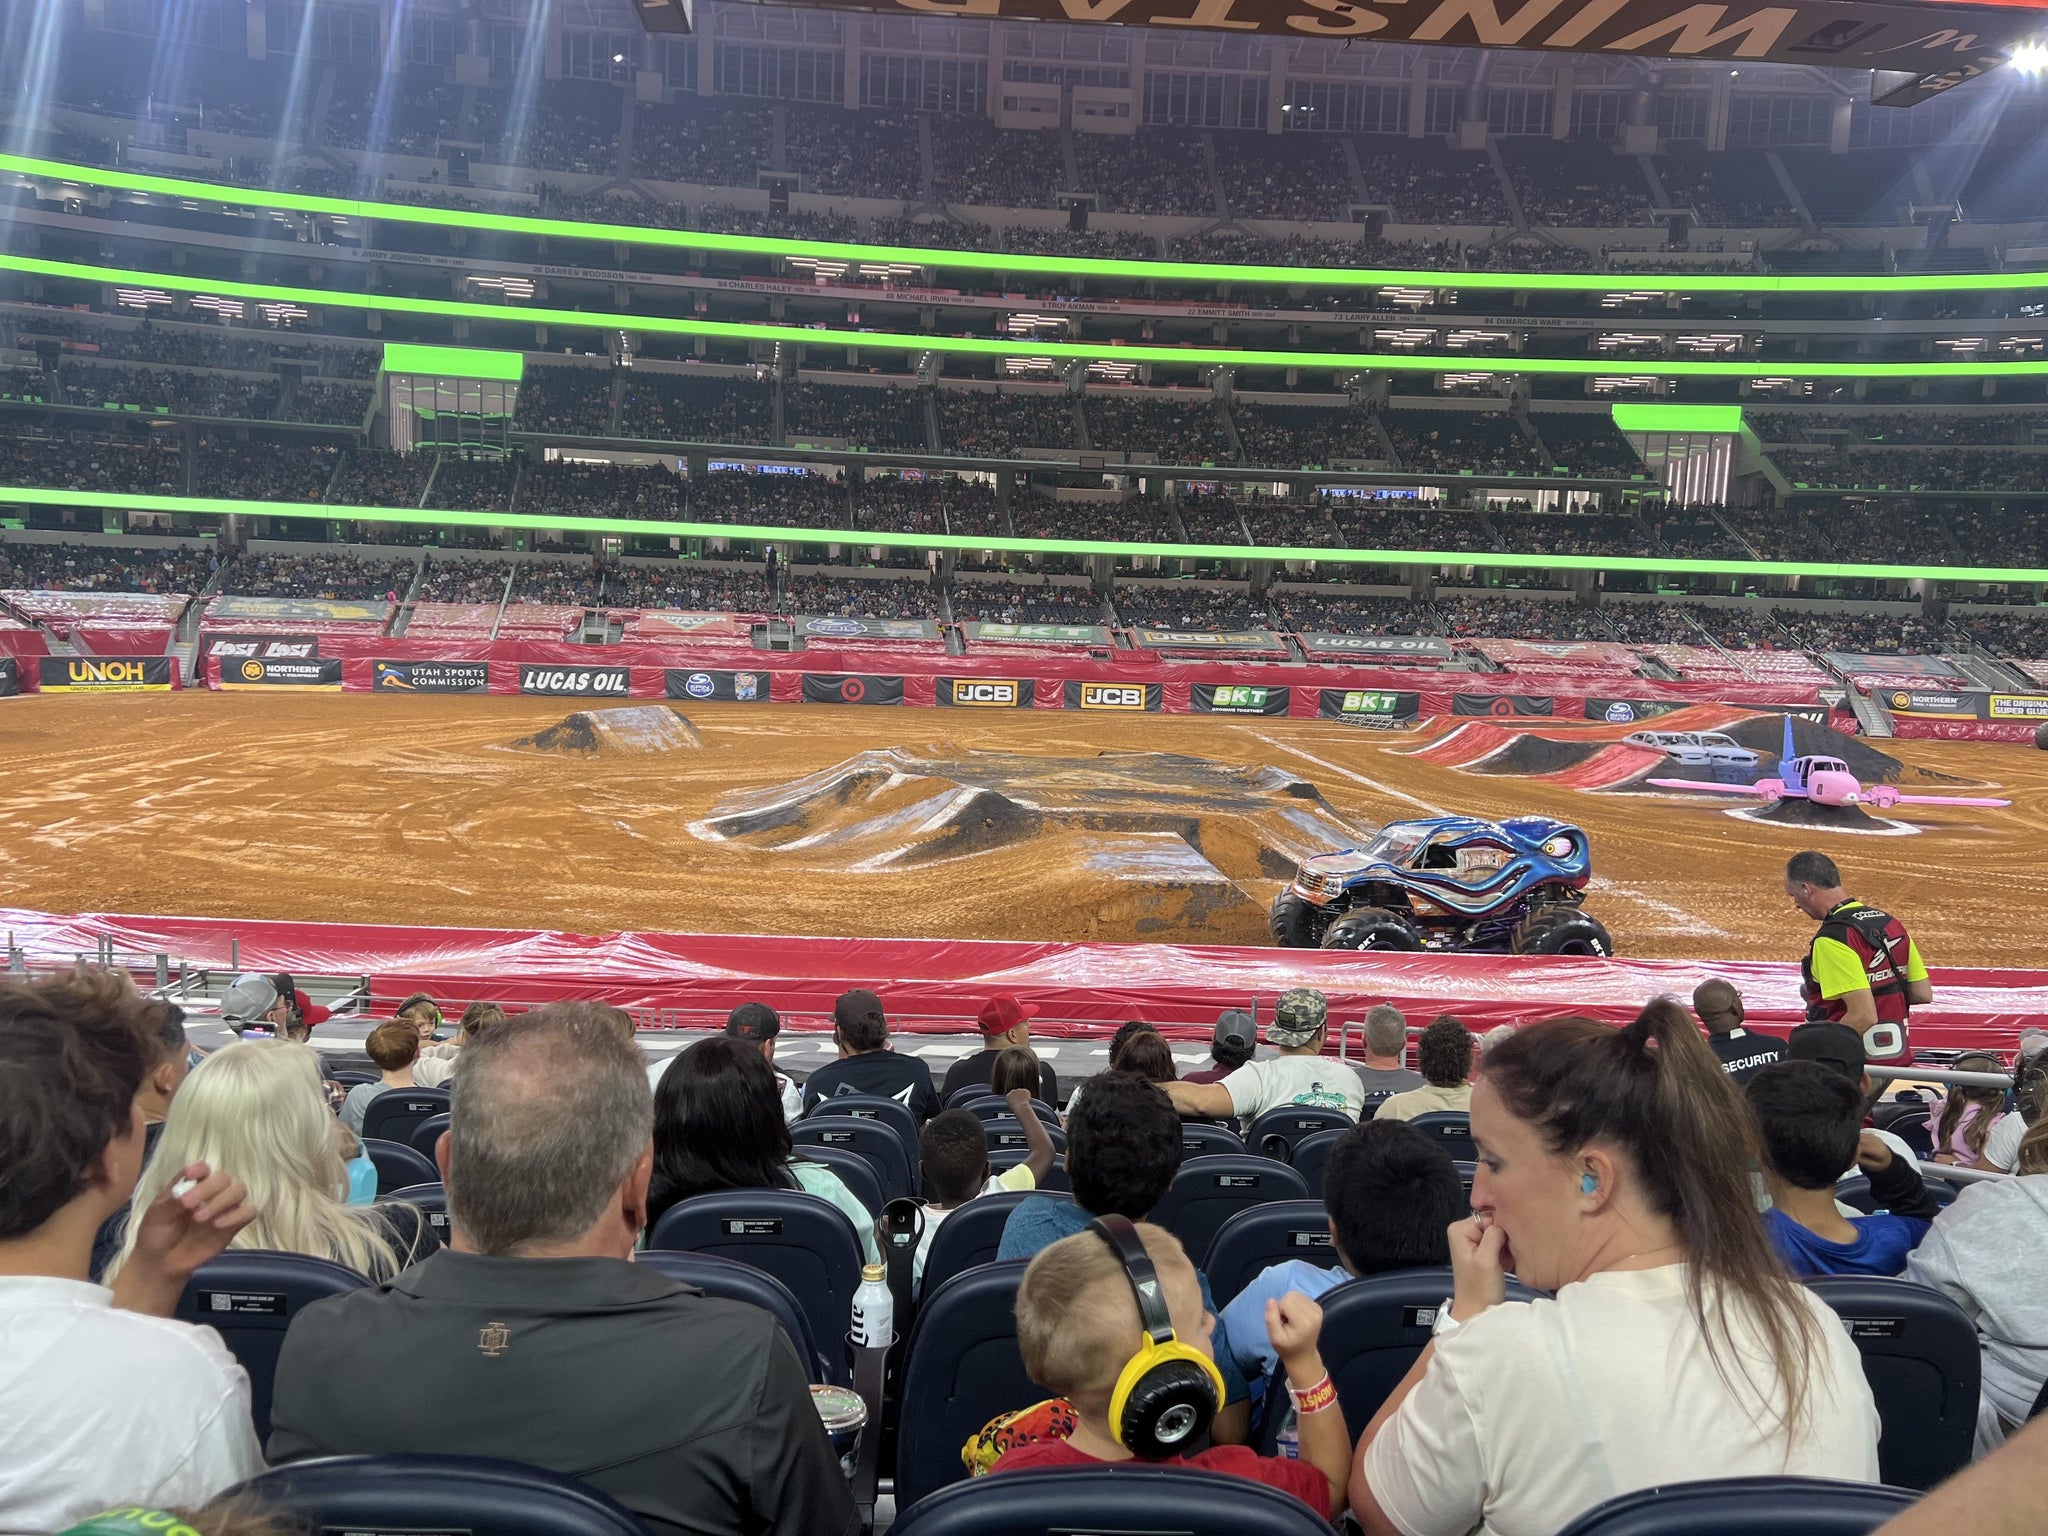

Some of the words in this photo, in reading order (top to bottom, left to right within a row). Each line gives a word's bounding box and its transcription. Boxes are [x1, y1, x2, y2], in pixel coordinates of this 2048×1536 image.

[390, 253, 431, 264] JOHNSON
[545, 267, 579, 277] DARREN
[582, 270, 625, 280] WOODSON
[717, 280, 727, 288] 94
[728, 281, 765, 291] CHARLES
[766, 284, 792, 293] HALEY
[897, 293, 928, 302] MICHAEL
[1198, 309, 1227, 317] EMMITT
[1346, 314, 1371, 322] LARRY
[1540, 319, 1562, 327] WARE
[982, 624, 1091, 637] BKT
[1315, 637, 1395, 649] LUCAS
[68, 661, 144, 682] UNOH
[266, 665, 320, 674] NORTHERN
[411, 668, 440, 677] UTAH
[445, 668, 485, 677] SPORTS
[411, 677, 485, 686] COMMISSION
[523, 671, 588, 690] LUCAS
[958, 685, 1013, 701] JCB
[1086, 688, 1140, 705] JCB
[1215, 688, 1267, 704] BKT
[1344, 693, 1397, 709] BKT
[1912, 696, 1957, 704] NORTHERN
[1995, 699, 2012, 707] THE
[1994, 706, 2025, 715] SUPER
[1357, 932, 1377, 951] BKT
[1590, 937, 1606, 958] BKT
[1721, 1050, 1780, 1074] SECURITY
